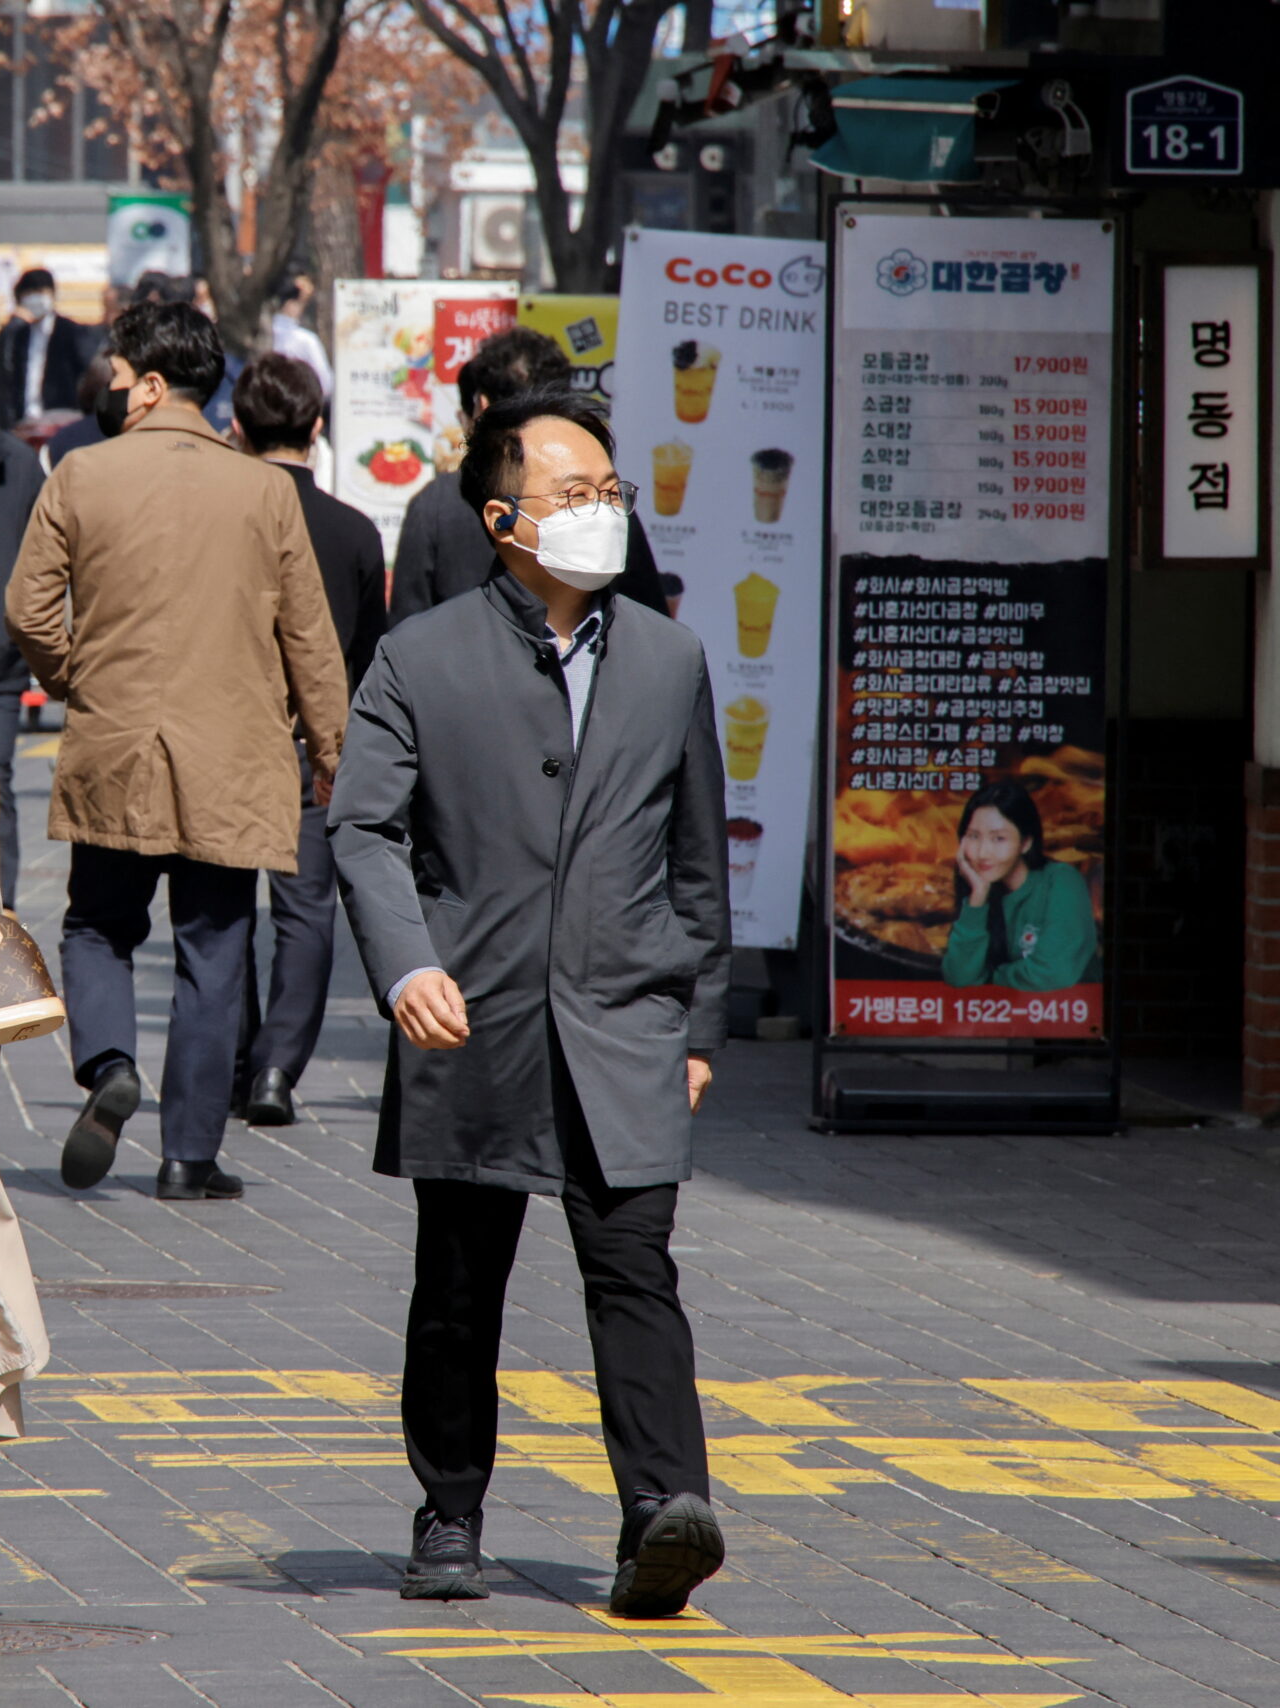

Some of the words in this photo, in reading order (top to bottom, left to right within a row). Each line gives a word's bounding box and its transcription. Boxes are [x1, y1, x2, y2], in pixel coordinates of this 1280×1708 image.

[1141, 123, 1226, 160] 18-1
[665, 257, 773, 289] CoCo
[931, 260, 1068, 295] 대한곱창
[664, 300, 729, 328] BEST
[739, 305, 817, 334] DRINK
[862, 396, 912, 415] 소곱창
[1187, 319, 1233, 512] 명동점
[861, 422, 912, 441] 소대창
[861, 448, 911, 467] 소막창
[965, 724, 1013, 743] #곱창
[949, 772, 981, 791] 곱창
[849, 997, 943, 1024] 가맹문의
[953, 999, 1089, 1024] 1522-9419
